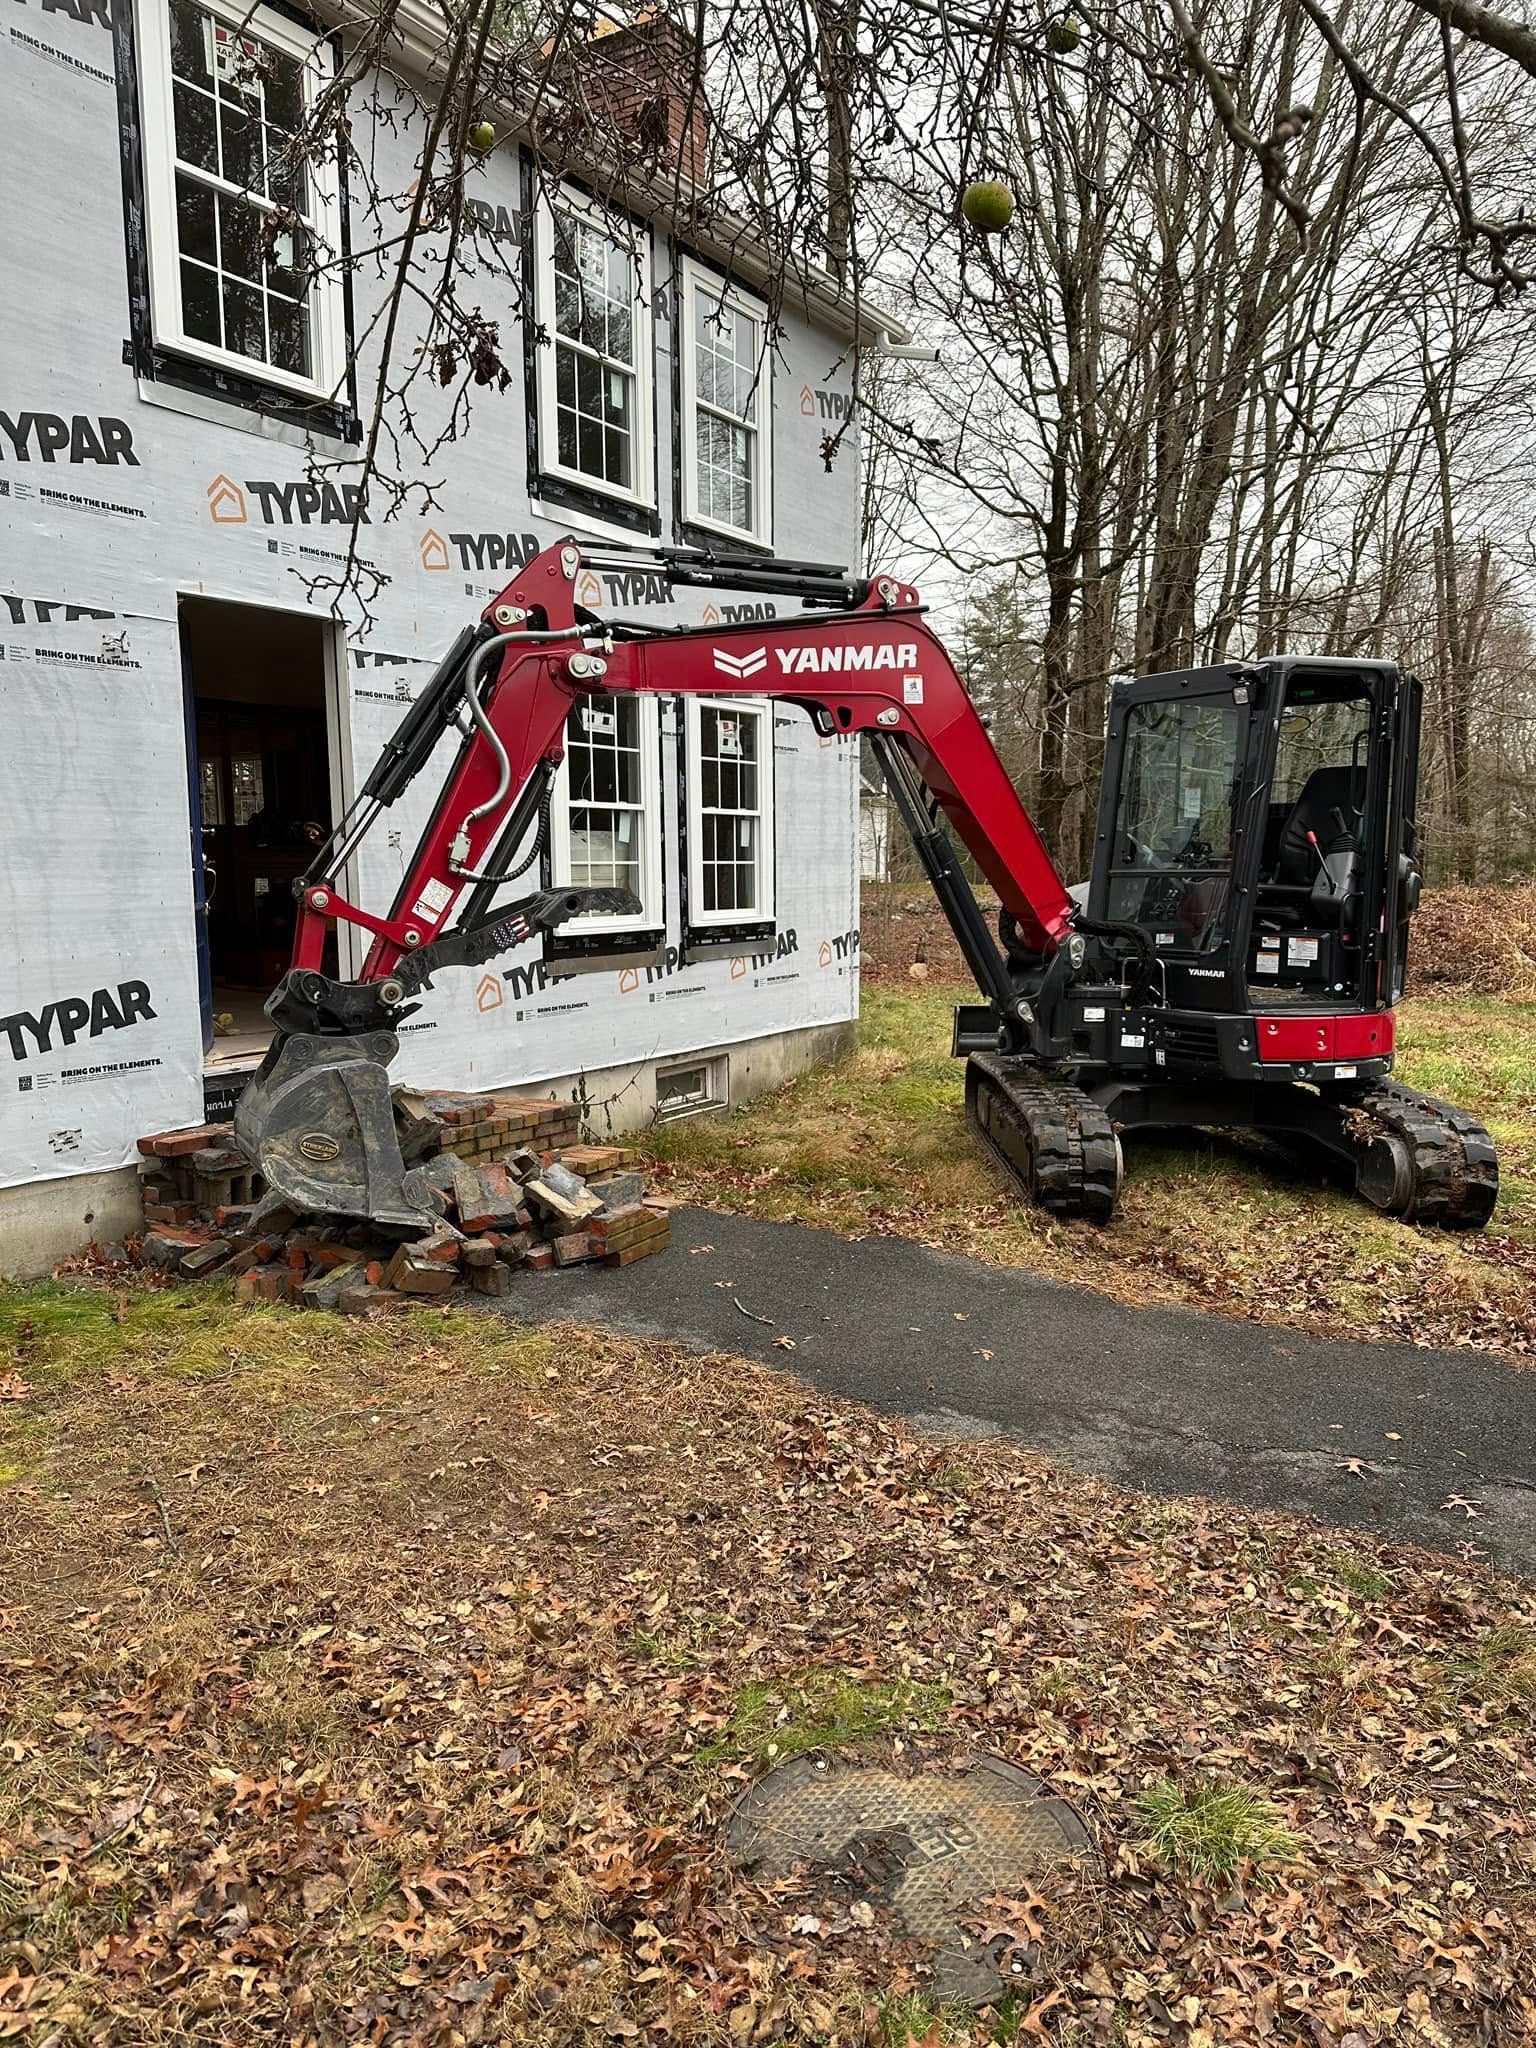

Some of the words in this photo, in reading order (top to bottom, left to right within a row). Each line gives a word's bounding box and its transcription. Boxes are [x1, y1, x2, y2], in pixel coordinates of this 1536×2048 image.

[10, 27, 40, 48] BRING
[41, 43, 55, 55] ON
[55, 50, 73, 64] THE
[74, 59, 117, 86] ELEMENT
[0, 410, 141, 466] YPAR
[39, 487, 68, 501] BRING
[69, 494, 83, 505] ON
[83, 498, 100, 508] THE
[101, 502, 147, 518] ELEMENTS.
[244, 481, 372, 524] TYPAR
[602, 574, 675, 607] TYPAR
[35, 648, 63, 659] BRING
[65, 650, 78, 660] ON
[78, 654, 96, 663] THE
[97, 657, 143, 669] ELEMENTS.
[774, 643, 918, 674] YANMAR
[1188, 967, 1225, 978] YANMAR
[0, 979, 158, 1061] TYPAR
[61, 1067, 88, 1078] BRING
[88, 1065, 102, 1074] ON
[102, 1062, 119, 1072] THE
[119, 1058, 163, 1070] ELEMENTS.
